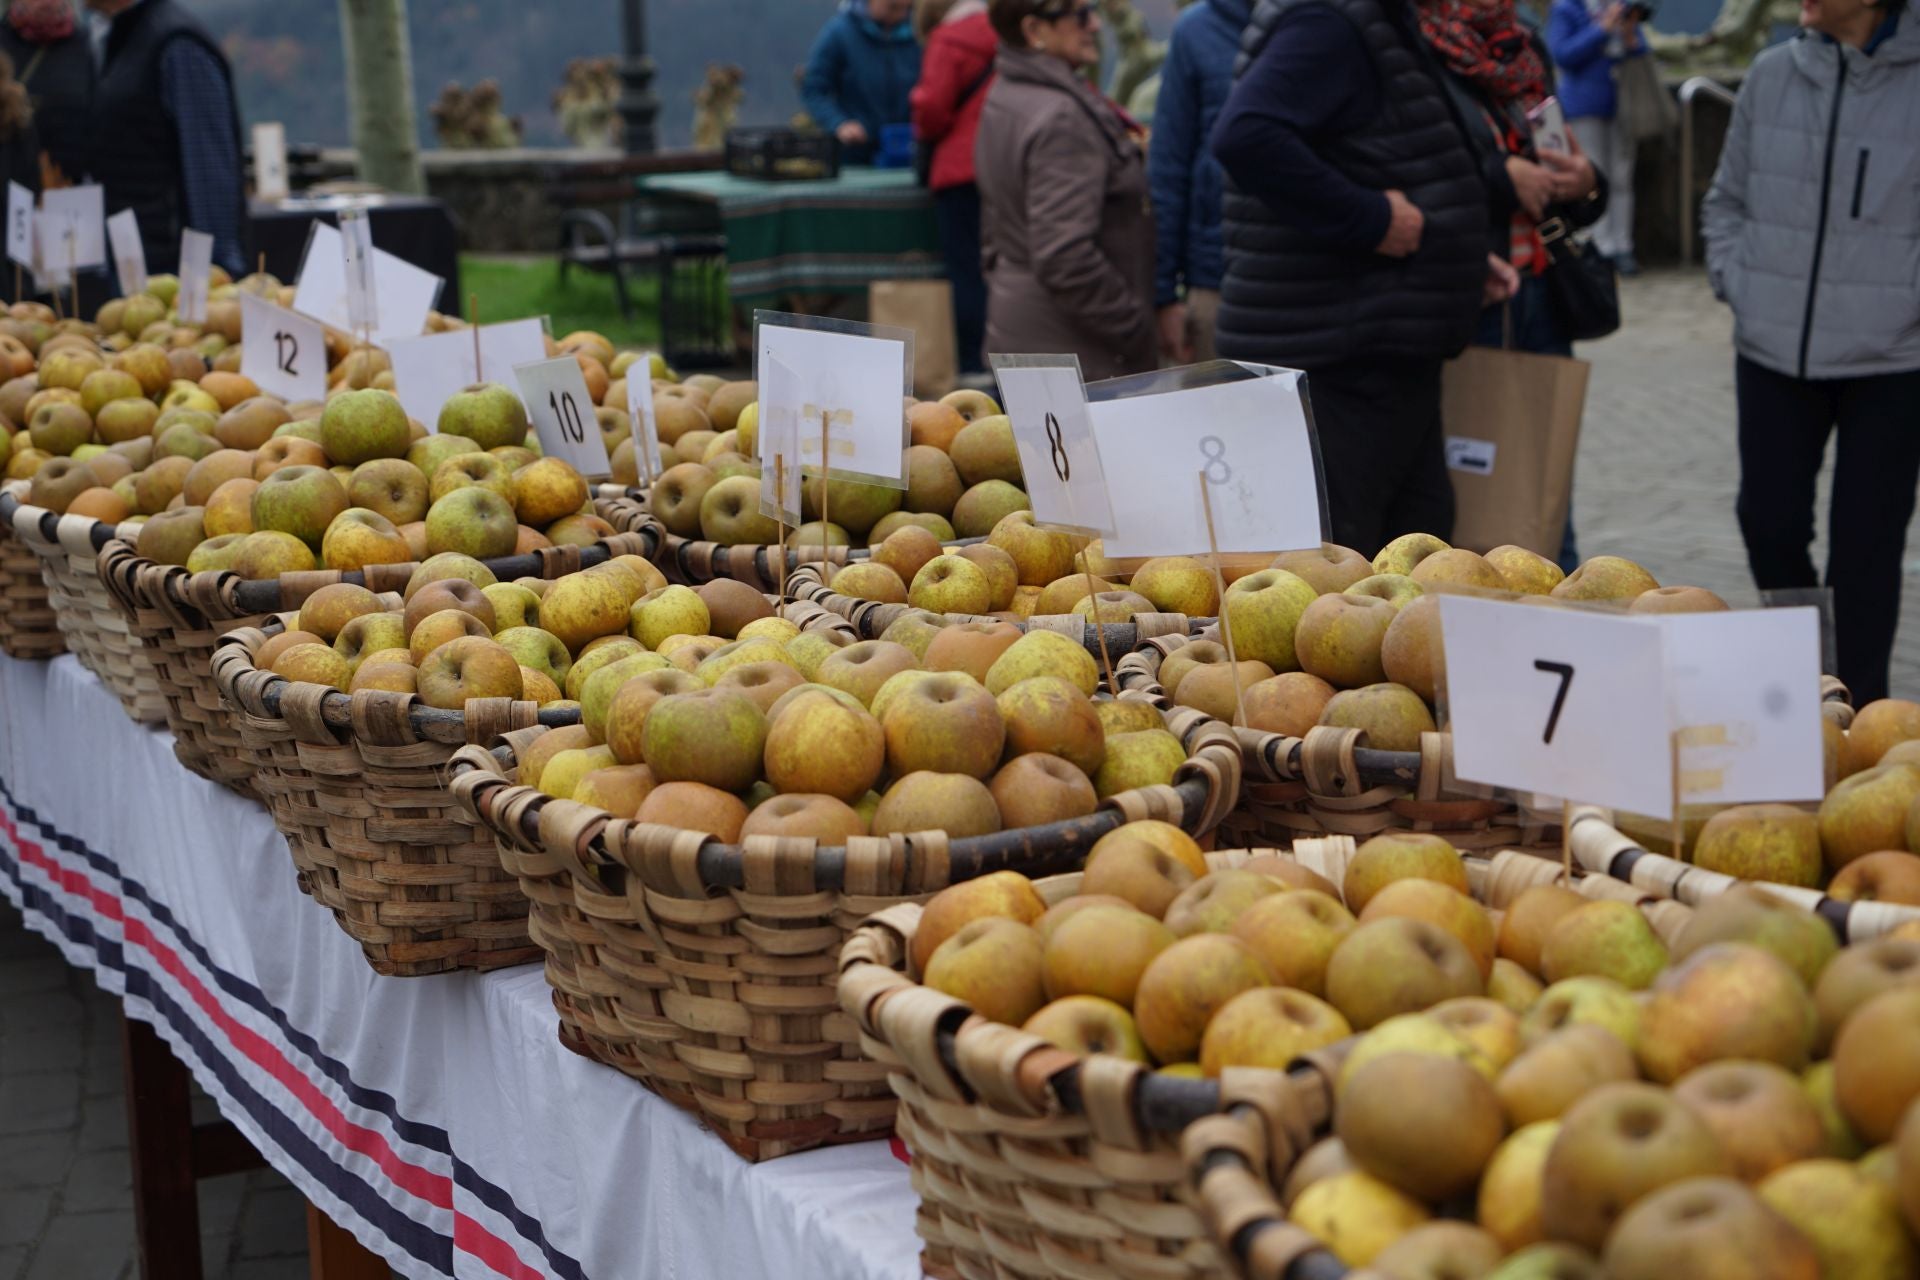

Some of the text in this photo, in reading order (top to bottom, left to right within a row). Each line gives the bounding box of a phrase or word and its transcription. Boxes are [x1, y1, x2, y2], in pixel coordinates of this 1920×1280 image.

[274, 331, 298, 376] 12
[549, 391, 584, 443] 10
[1045, 412, 1070, 482] 8
[1199, 435, 1232, 485] 8
[1534, 659, 1575, 745] 7
